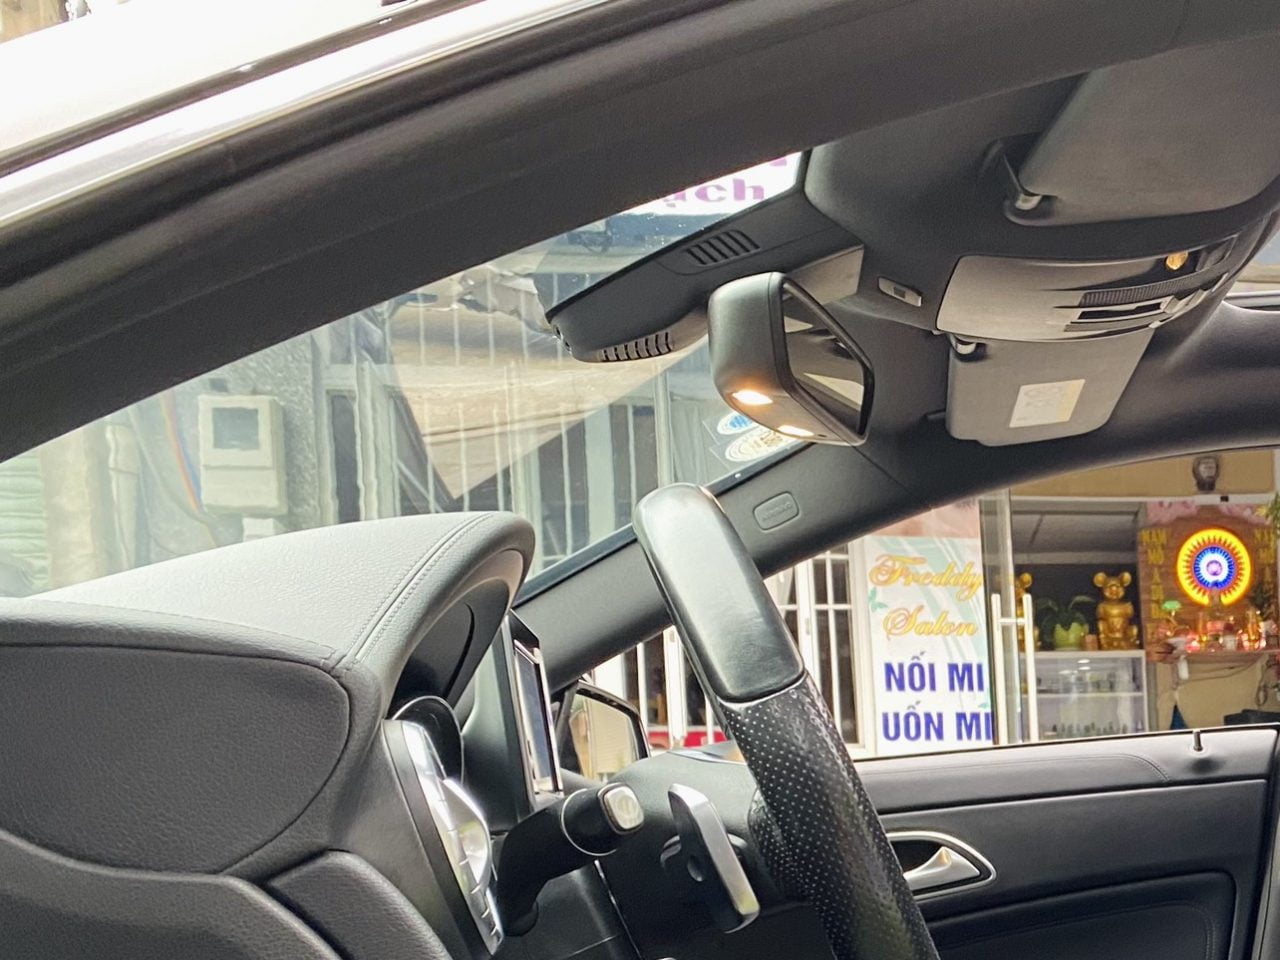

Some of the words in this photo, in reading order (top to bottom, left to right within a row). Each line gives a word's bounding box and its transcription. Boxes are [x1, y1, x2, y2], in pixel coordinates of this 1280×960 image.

[868, 554, 984, 601] Freddy
[883, 605, 977, 640] Salon
[884, 651, 937, 692] NỐI
[948, 663, 985, 692] MI
[882, 700, 944, 741] UỐN
[956, 712, 992, 741] MI
